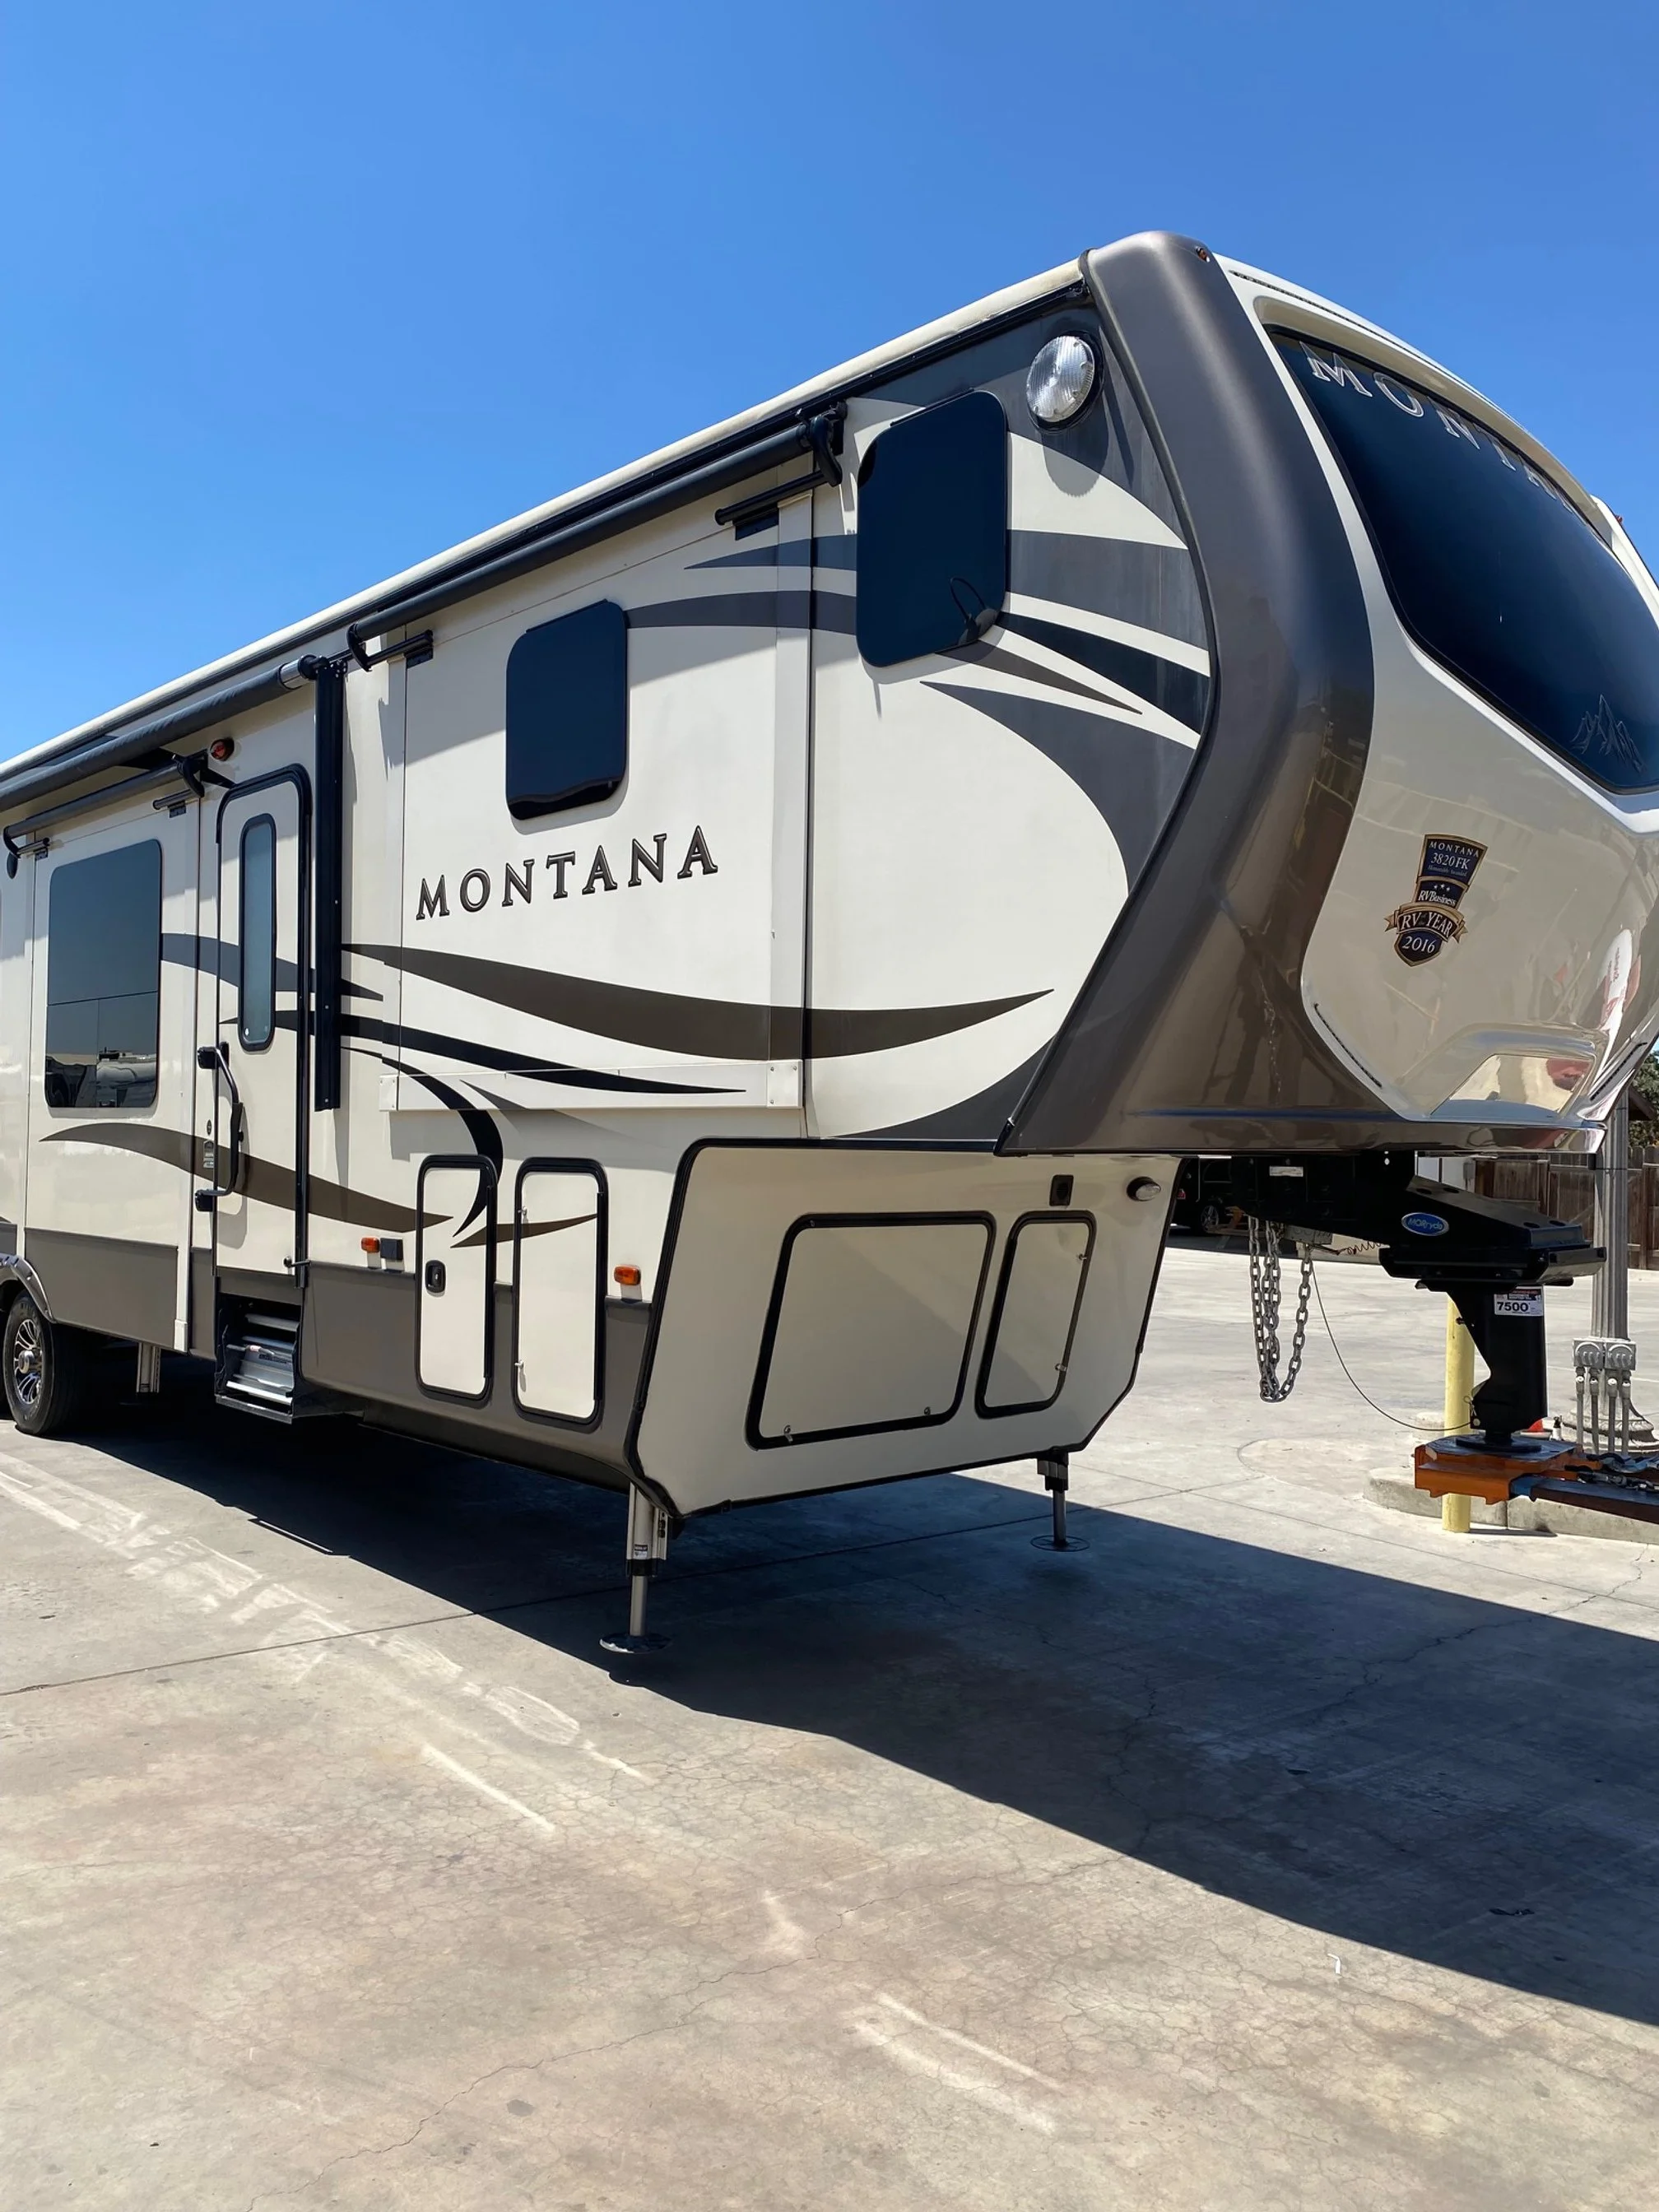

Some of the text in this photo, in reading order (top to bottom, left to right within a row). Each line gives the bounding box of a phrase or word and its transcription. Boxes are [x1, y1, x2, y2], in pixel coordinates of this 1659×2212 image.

[1429, 841, 1480, 857] MONTANA
[1430, 853, 1471, 870] 3820FK
[416, 825, 719, 921] MONTANA
[1418, 890, 1457, 907] RVBusiness
[1401, 912, 1422, 930] RV
[1425, 912, 1453, 938] YEAR
[1401, 936, 1438, 954] 2016
[1496, 1302, 1529, 1313] 7500
